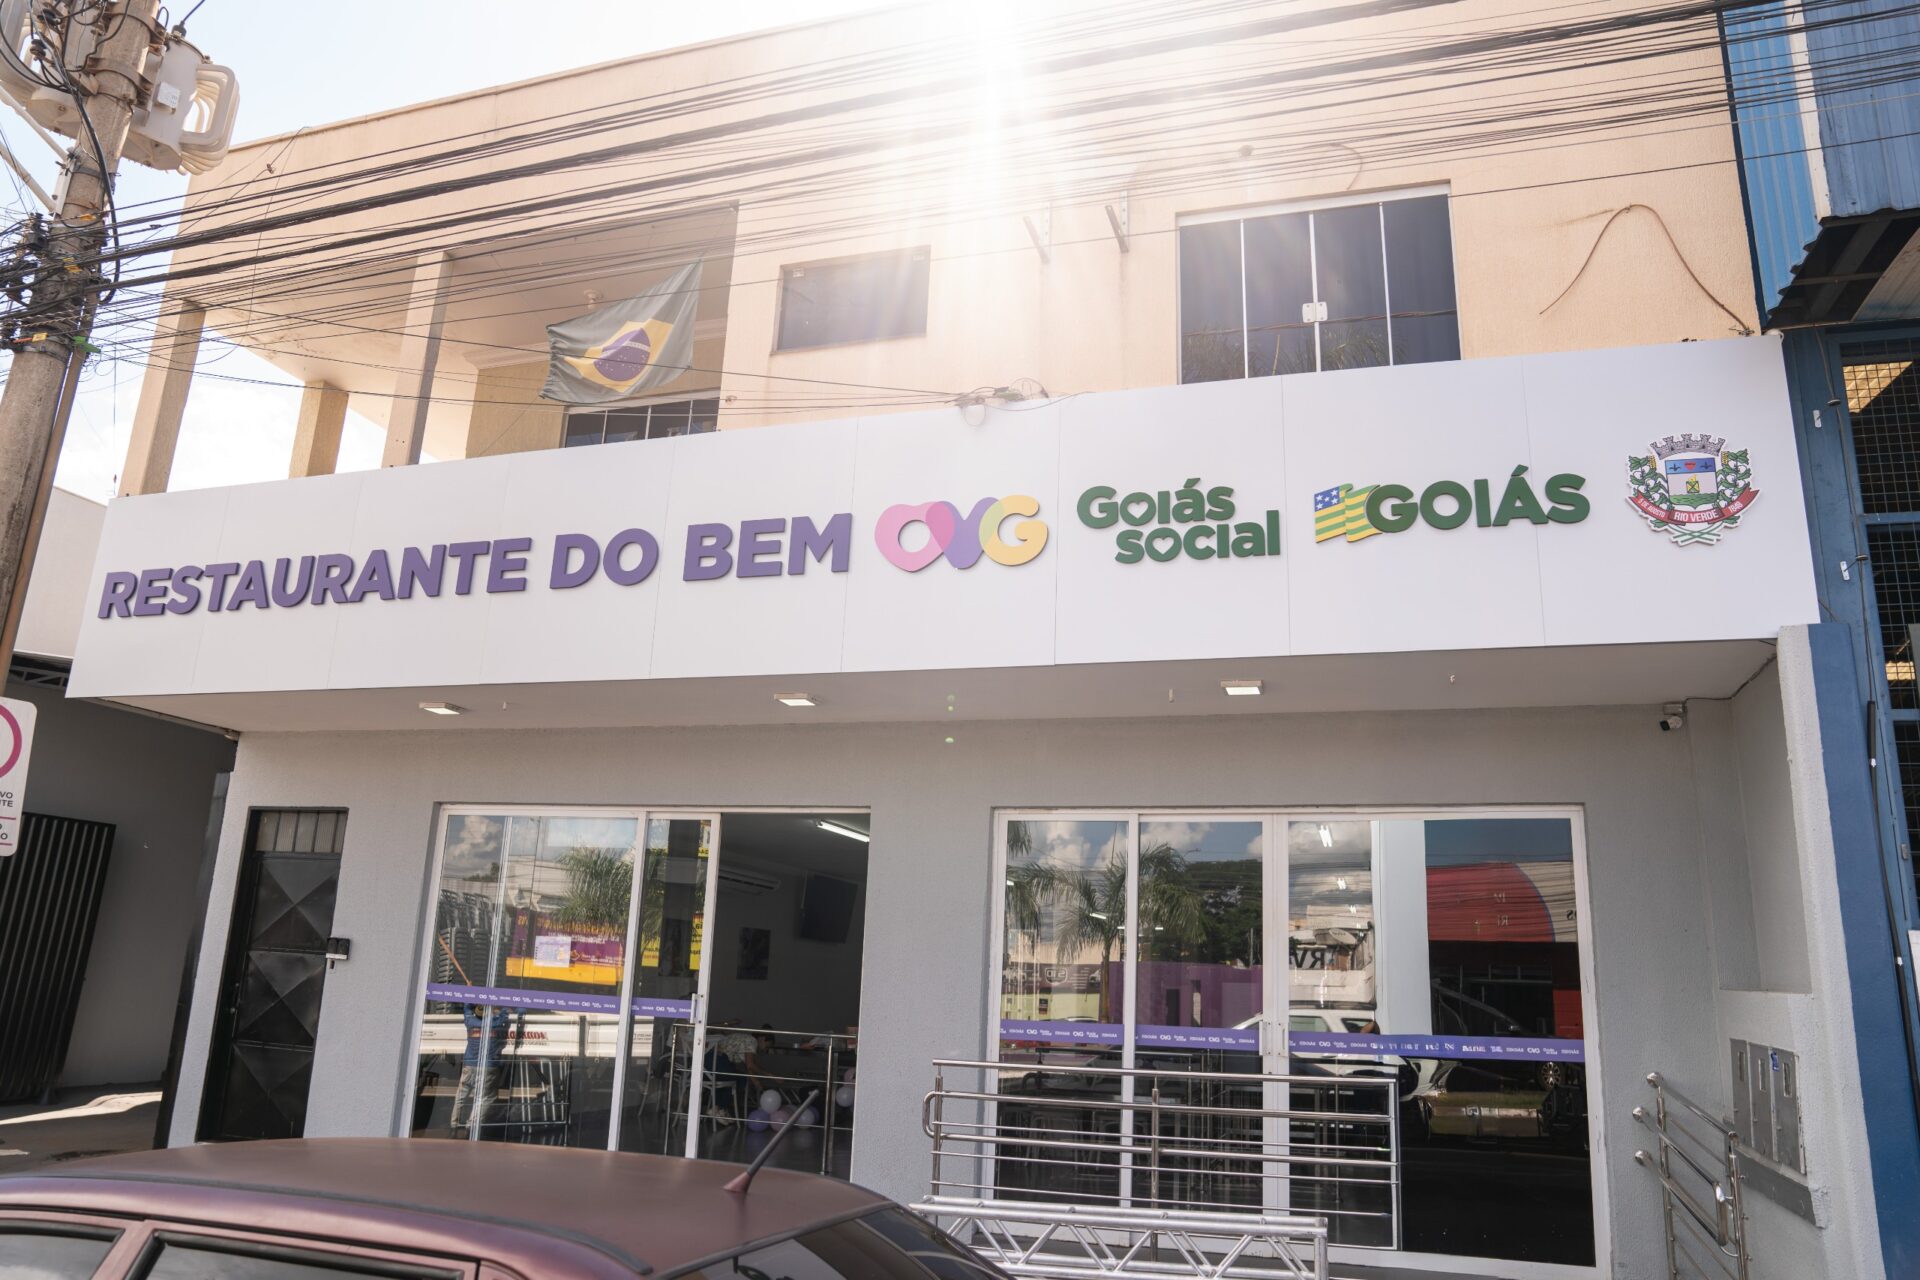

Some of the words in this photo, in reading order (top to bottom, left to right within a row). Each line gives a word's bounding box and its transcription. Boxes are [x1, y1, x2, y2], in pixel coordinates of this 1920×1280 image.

[1366, 465, 1592, 534] GOIÁS
[1673, 511, 1689, 522] RIO
[1689, 509, 1719, 522] VERDE
[98, 537, 533, 619] RESTAURANTE
[549, 528, 659, 590] DO
[683, 513, 852, 581] BEM
[1115, 510, 1281, 564] social
